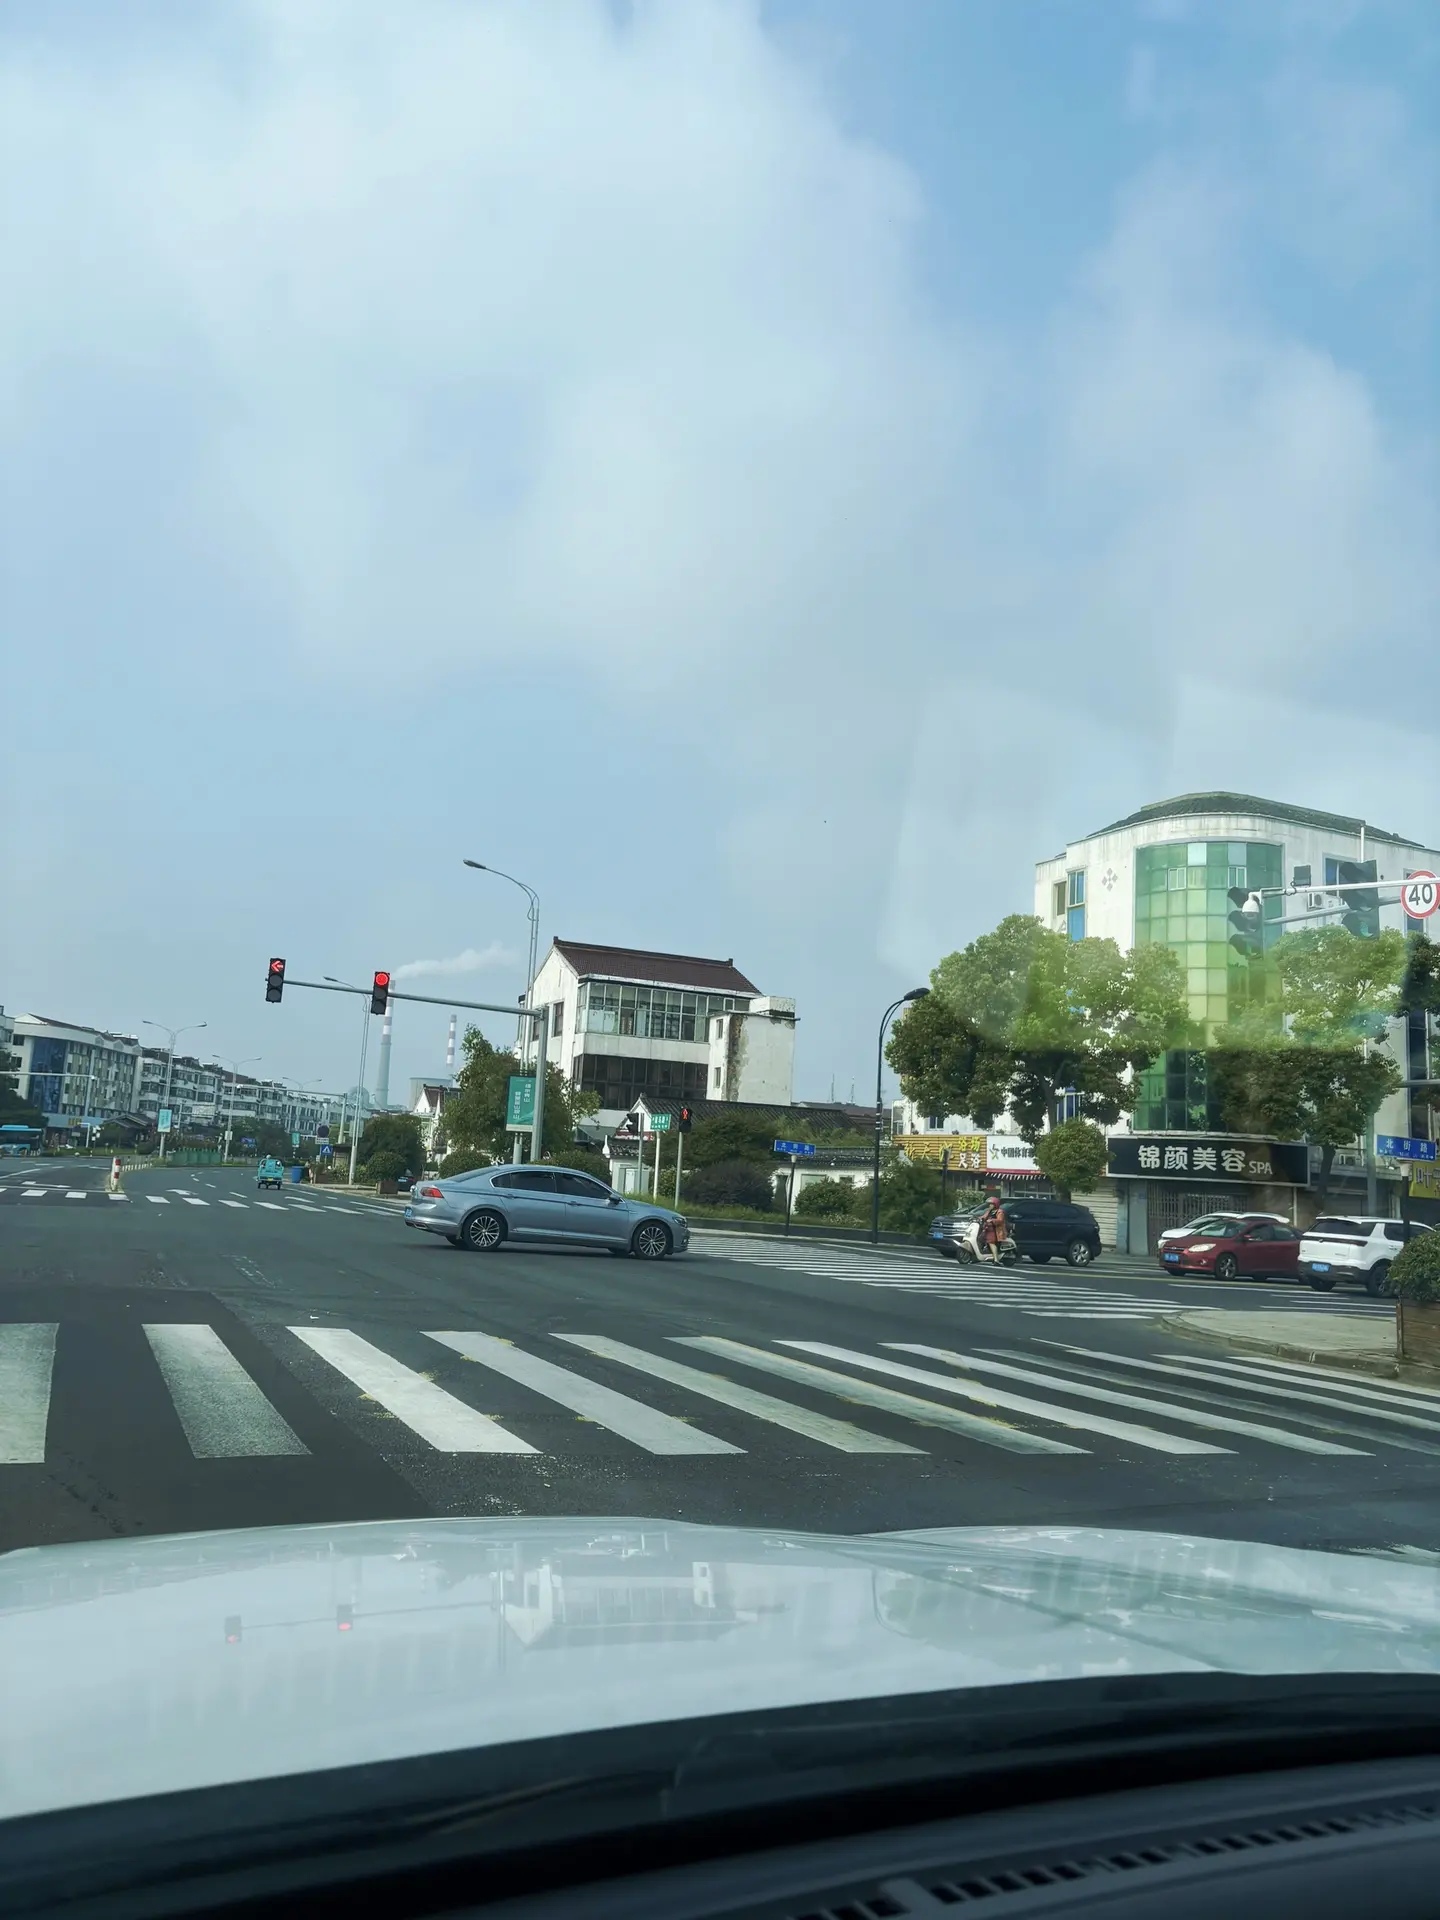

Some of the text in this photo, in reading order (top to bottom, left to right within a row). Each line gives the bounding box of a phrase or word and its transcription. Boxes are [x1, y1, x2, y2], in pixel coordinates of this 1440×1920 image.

[1408, 884, 1433, 906] 40
[1385, 1138, 1428, 1153] 北街路
[958, 1153, 981, 1169] 足浴
[1137, 1144, 1273, 1175] 锦颜美容 SPA
